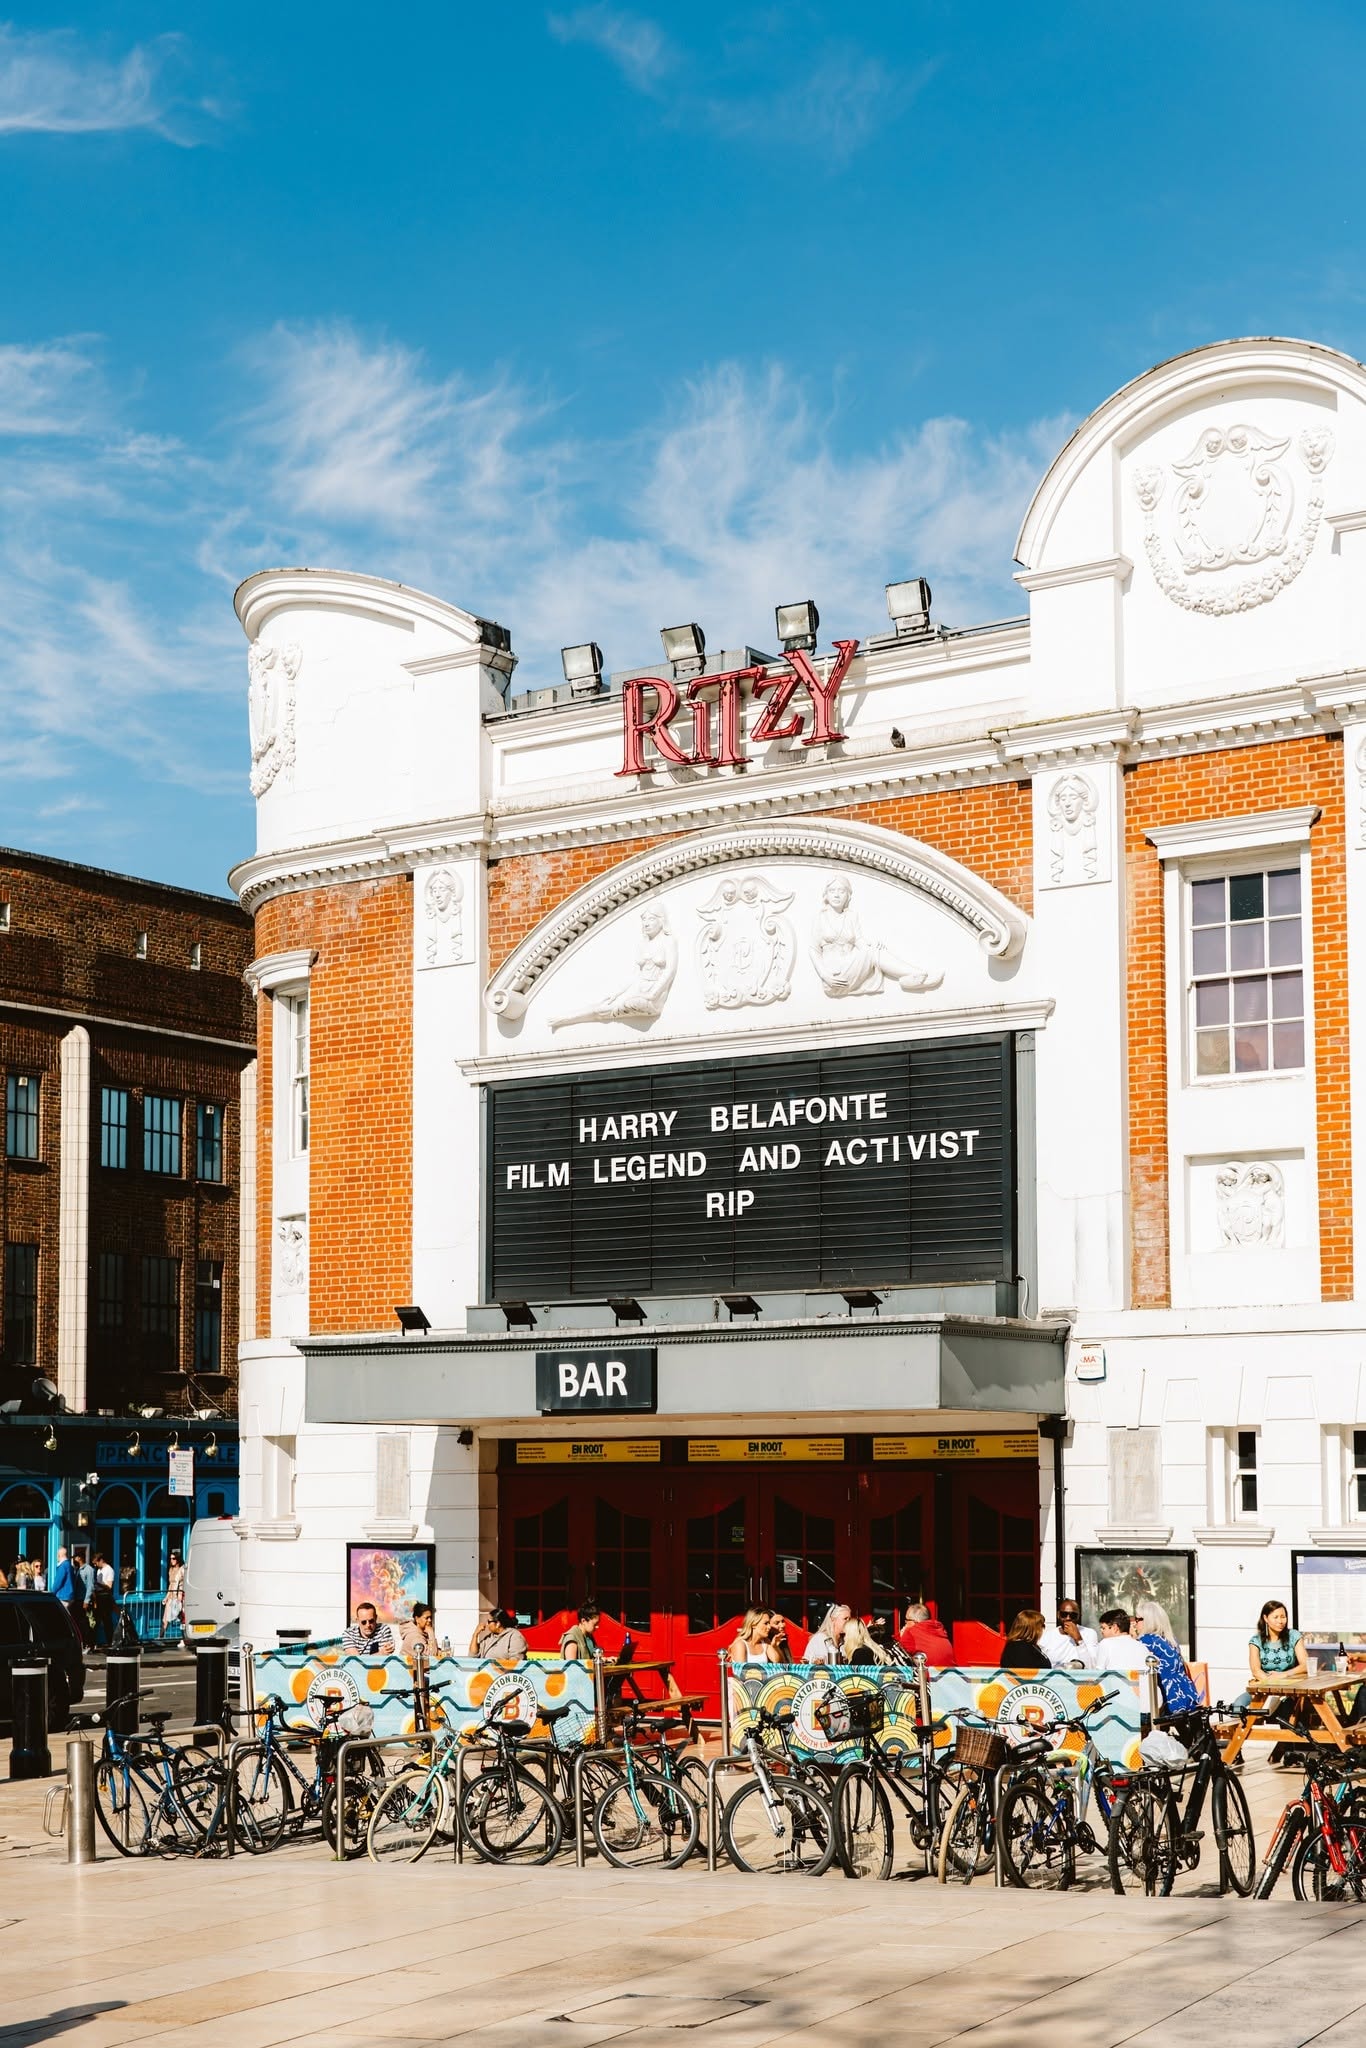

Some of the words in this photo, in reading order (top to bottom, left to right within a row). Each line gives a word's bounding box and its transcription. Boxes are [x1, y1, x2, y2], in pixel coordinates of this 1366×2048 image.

[580, 1111, 677, 1143] HARRY
[710, 1093, 888, 1132] BELAFONTE
[506, 1162, 570, 1190] FILM
[593, 1152, 707, 1184] LEGEND
[738, 1144, 801, 1173] AND
[824, 1130, 980, 1167] ACTIVIST
[706, 1190, 755, 1218] RIP
[558, 1362, 628, 1398] BAR
[572, 1444, 582, 1454] EN
[583, 1444, 604, 1454] ROOT
[748, 1442, 759, 1452] EN
[761, 1441, 783, 1452] ROOT
[938, 1439, 950, 1450] EN
[952, 1438, 976, 1449] ROOT
[308, 1670, 332, 1703] BRIXTON
[333, 1671, 358, 1704] BREWERY
[485, 1675, 511, 1708] BRIXTON
[512, 1675, 536, 1708] BREWERY
[793, 1682, 818, 1717] BRIXTON
[1000, 1687, 1030, 1722] BRIXTON
[1031, 1686, 1065, 1719] BREWER
